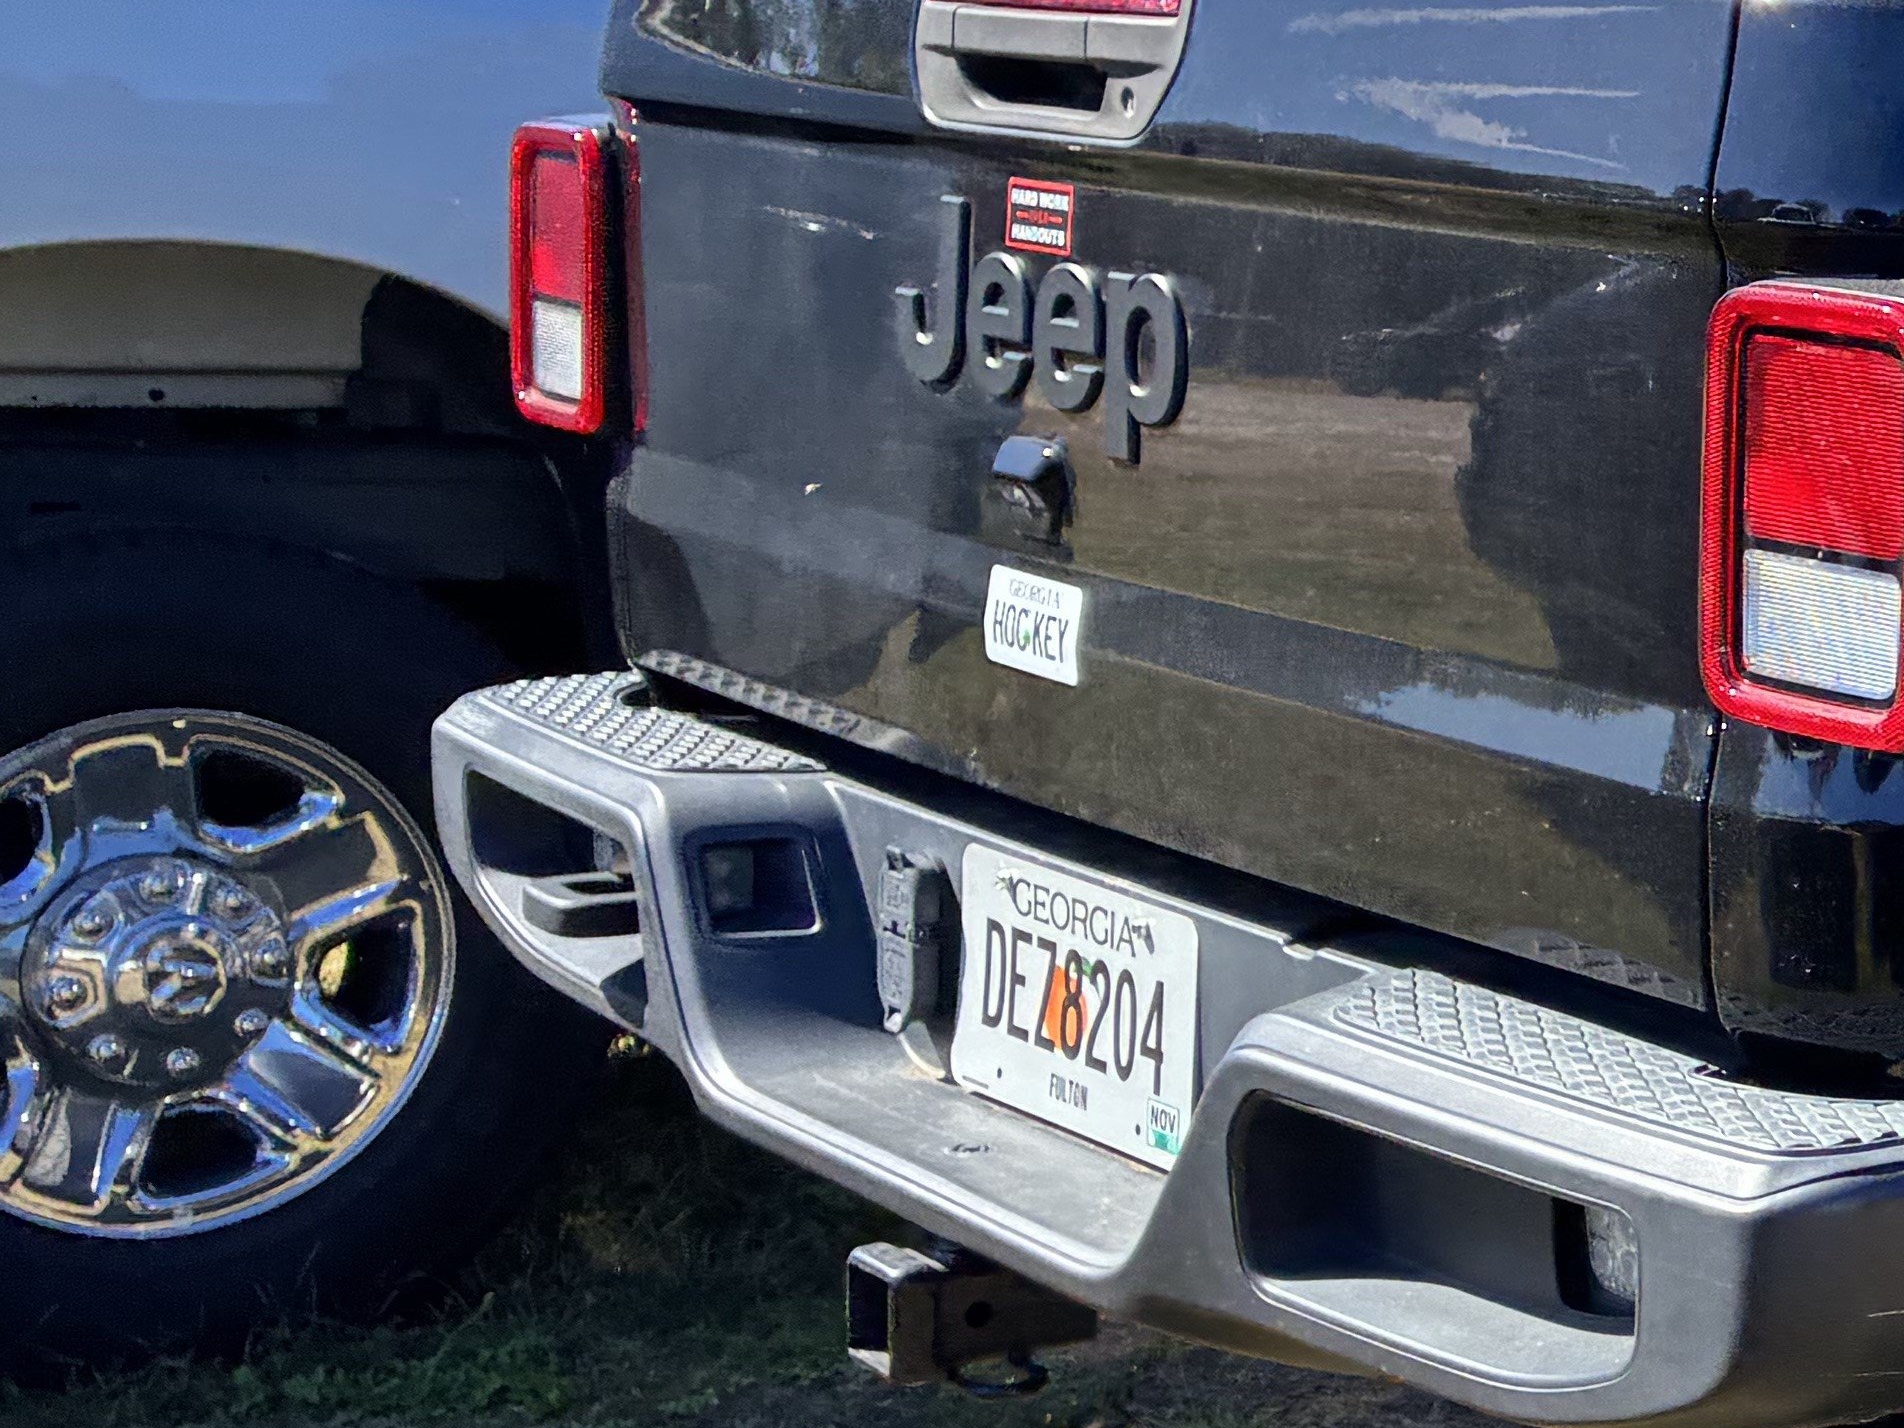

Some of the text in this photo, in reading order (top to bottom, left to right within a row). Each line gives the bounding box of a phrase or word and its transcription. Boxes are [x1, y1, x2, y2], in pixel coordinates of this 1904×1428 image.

[895, 194, 1189, 465] Jeep
[1010, 578, 1060, 609] GEORGIA
[993, 599, 1069, 663] HOCKEY
[1012, 877, 1137, 958] GEORGIA
[981, 917, 1165, 1097] DEZ8204
[1049, 1072, 1088, 1111] FULTON
[1151, 1105, 1176, 1133] NOV
